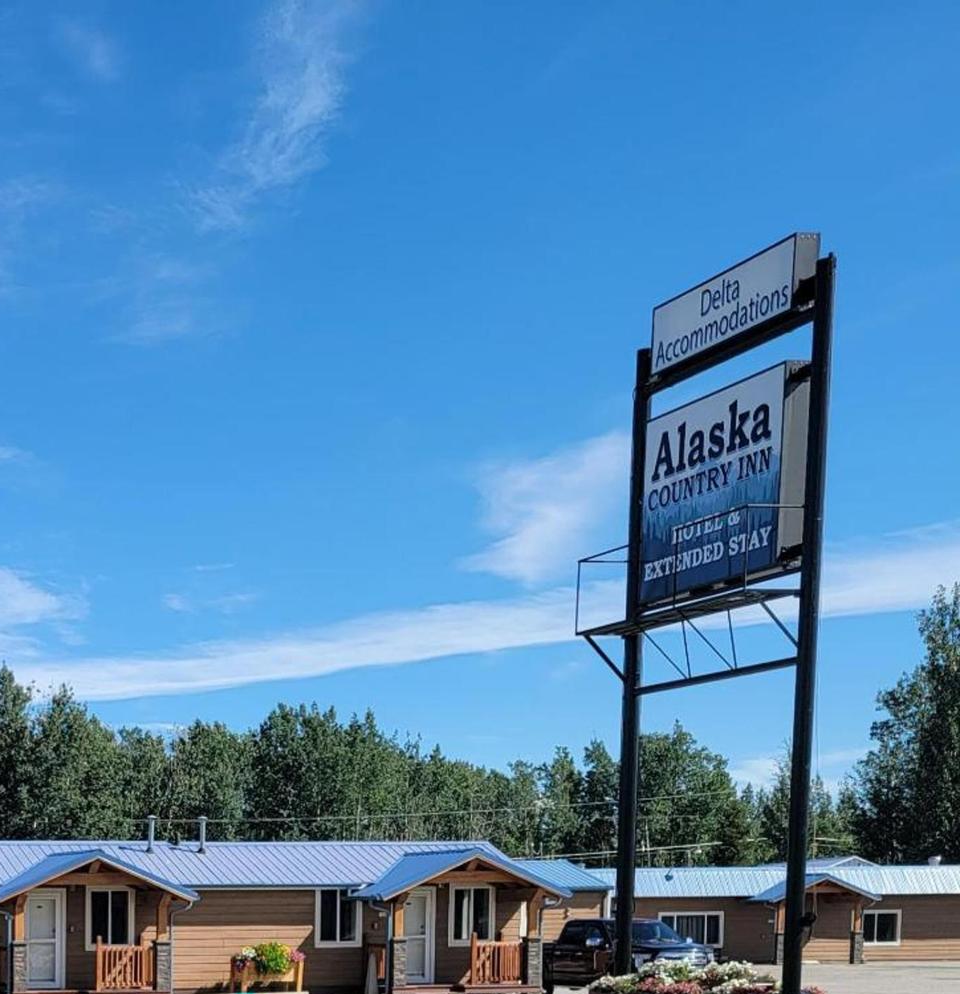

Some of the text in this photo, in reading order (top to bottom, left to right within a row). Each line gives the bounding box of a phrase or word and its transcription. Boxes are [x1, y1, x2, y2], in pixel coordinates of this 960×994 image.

[655, 284, 789, 368] Accommodations
[700, 279, 740, 317] Delta
[651, 400, 772, 481] Alaska
[648, 446, 772, 511] COUNTRY INN
[644, 526, 772, 582] EXTENDED STAY
[671, 507, 740, 544] HOTEL &
